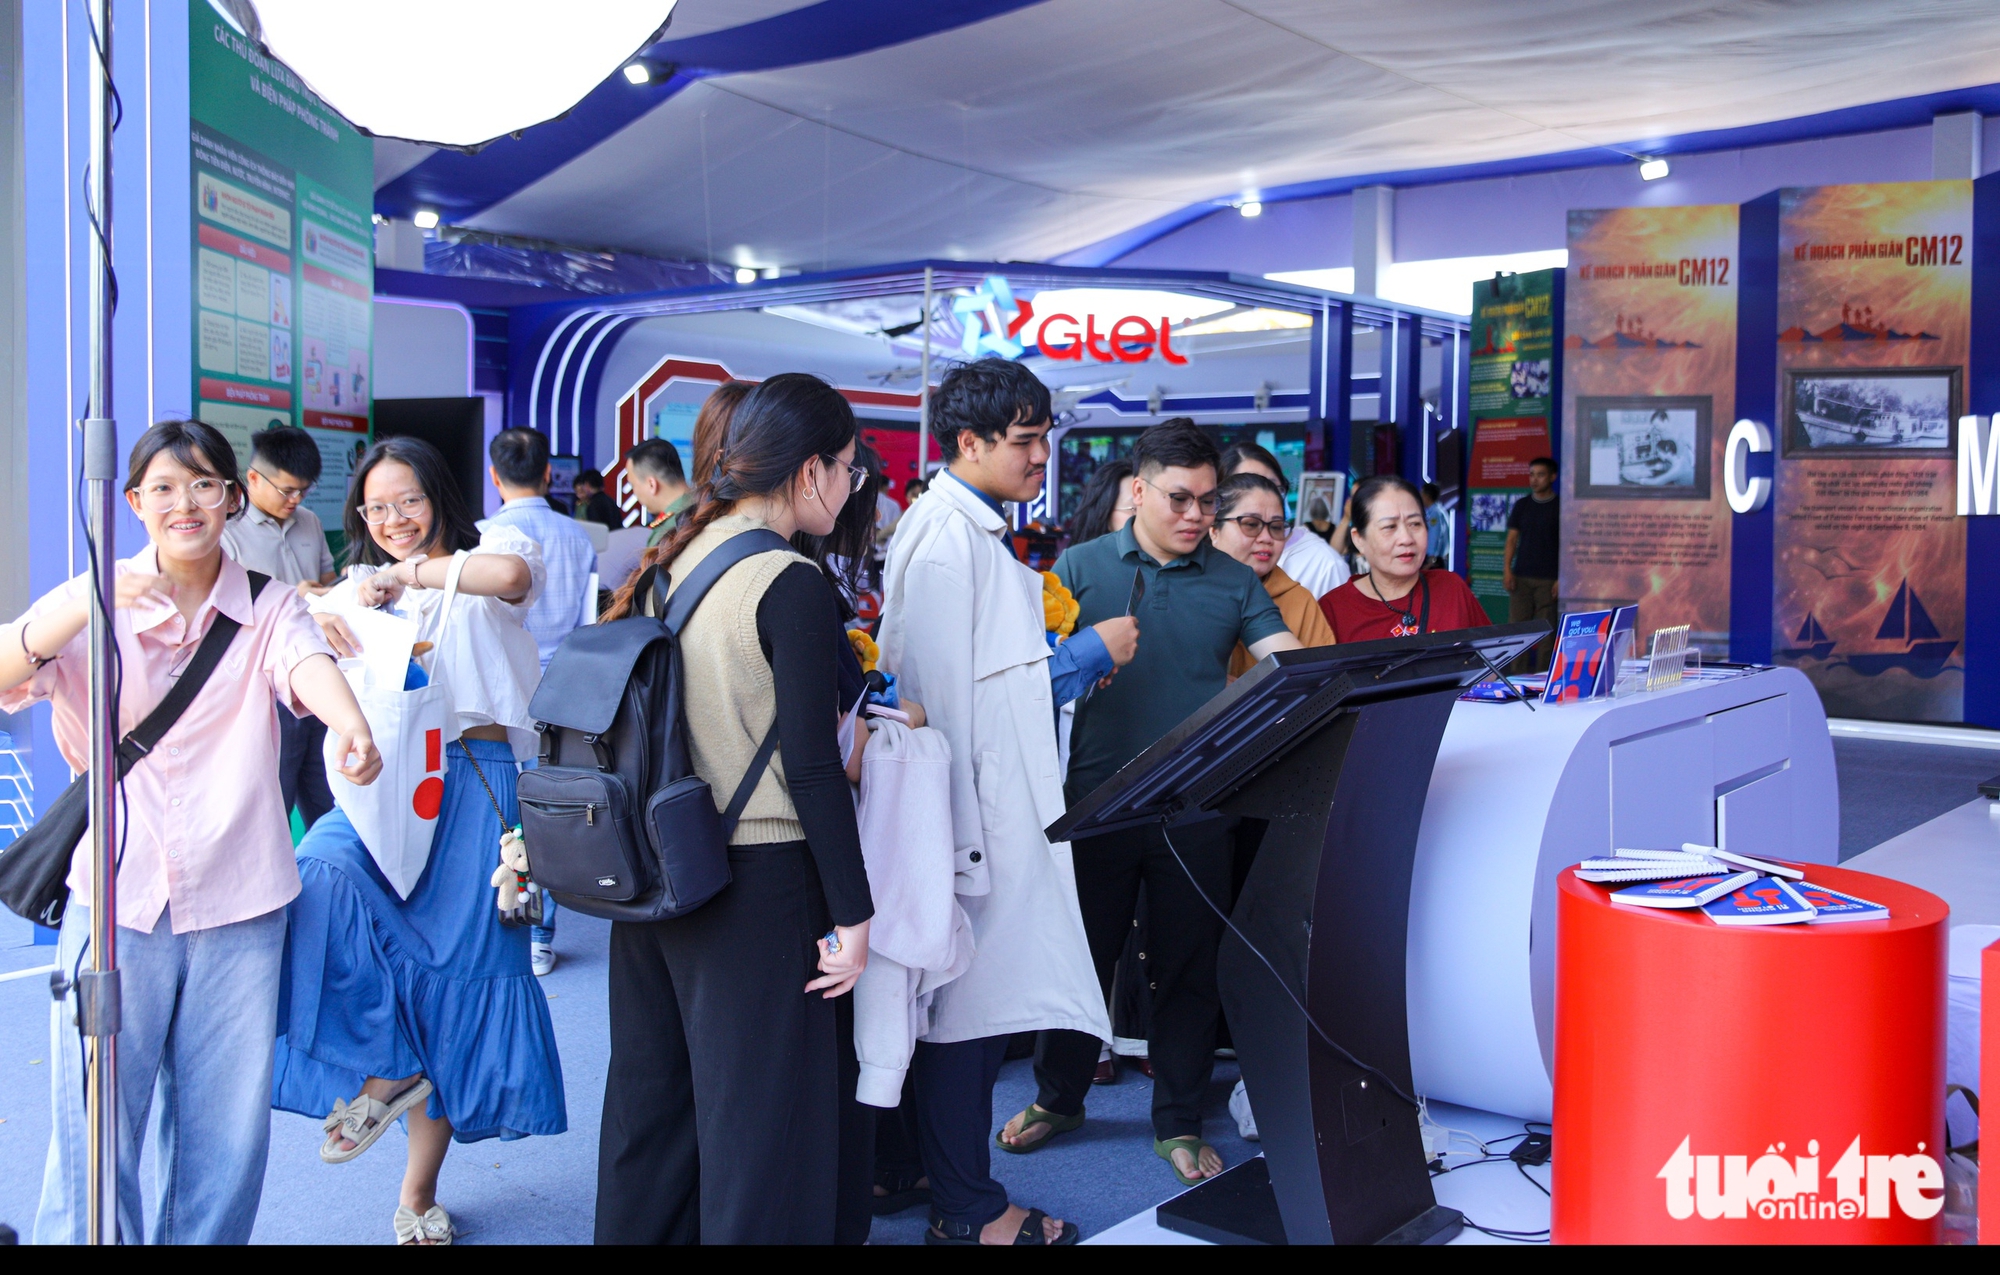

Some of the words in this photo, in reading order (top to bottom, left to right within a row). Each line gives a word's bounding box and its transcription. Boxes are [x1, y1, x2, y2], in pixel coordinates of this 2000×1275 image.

[214, 24, 230, 49] CÁC
[231, 35, 247, 60] THỦ
[248, 46, 270, 75] ĐOẠN
[250, 74, 260, 94] VÀ
[262, 82, 277, 106] BIỆN
[279, 91, 296, 116] PHÁP
[297, 102, 319, 131] PHÒNG
[319, 117, 339, 144] TRÁNH
[1794, 242, 1809, 261] KẾ
[1810, 244, 1845, 263] HOẠCH
[1848, 240, 1876, 260] PHẢN
[1878, 241, 1903, 259] GIÁN
[1906, 235, 1963, 267] CM12
[1579, 263, 1592, 280] KẾ
[1593, 264, 1625, 282] HOẠCH
[1628, 262, 1653, 279] PHẢN
[1654, 262, 1676, 279] GIÁN
[1679, 257, 1729, 287] CM12
[1037, 313, 1188, 365] Gtel
[1723, 419, 1773, 514] C
[1568, 628, 1581, 637] got
[1580, 624, 1597, 636] you!
[1570, 619, 1581, 627] we
